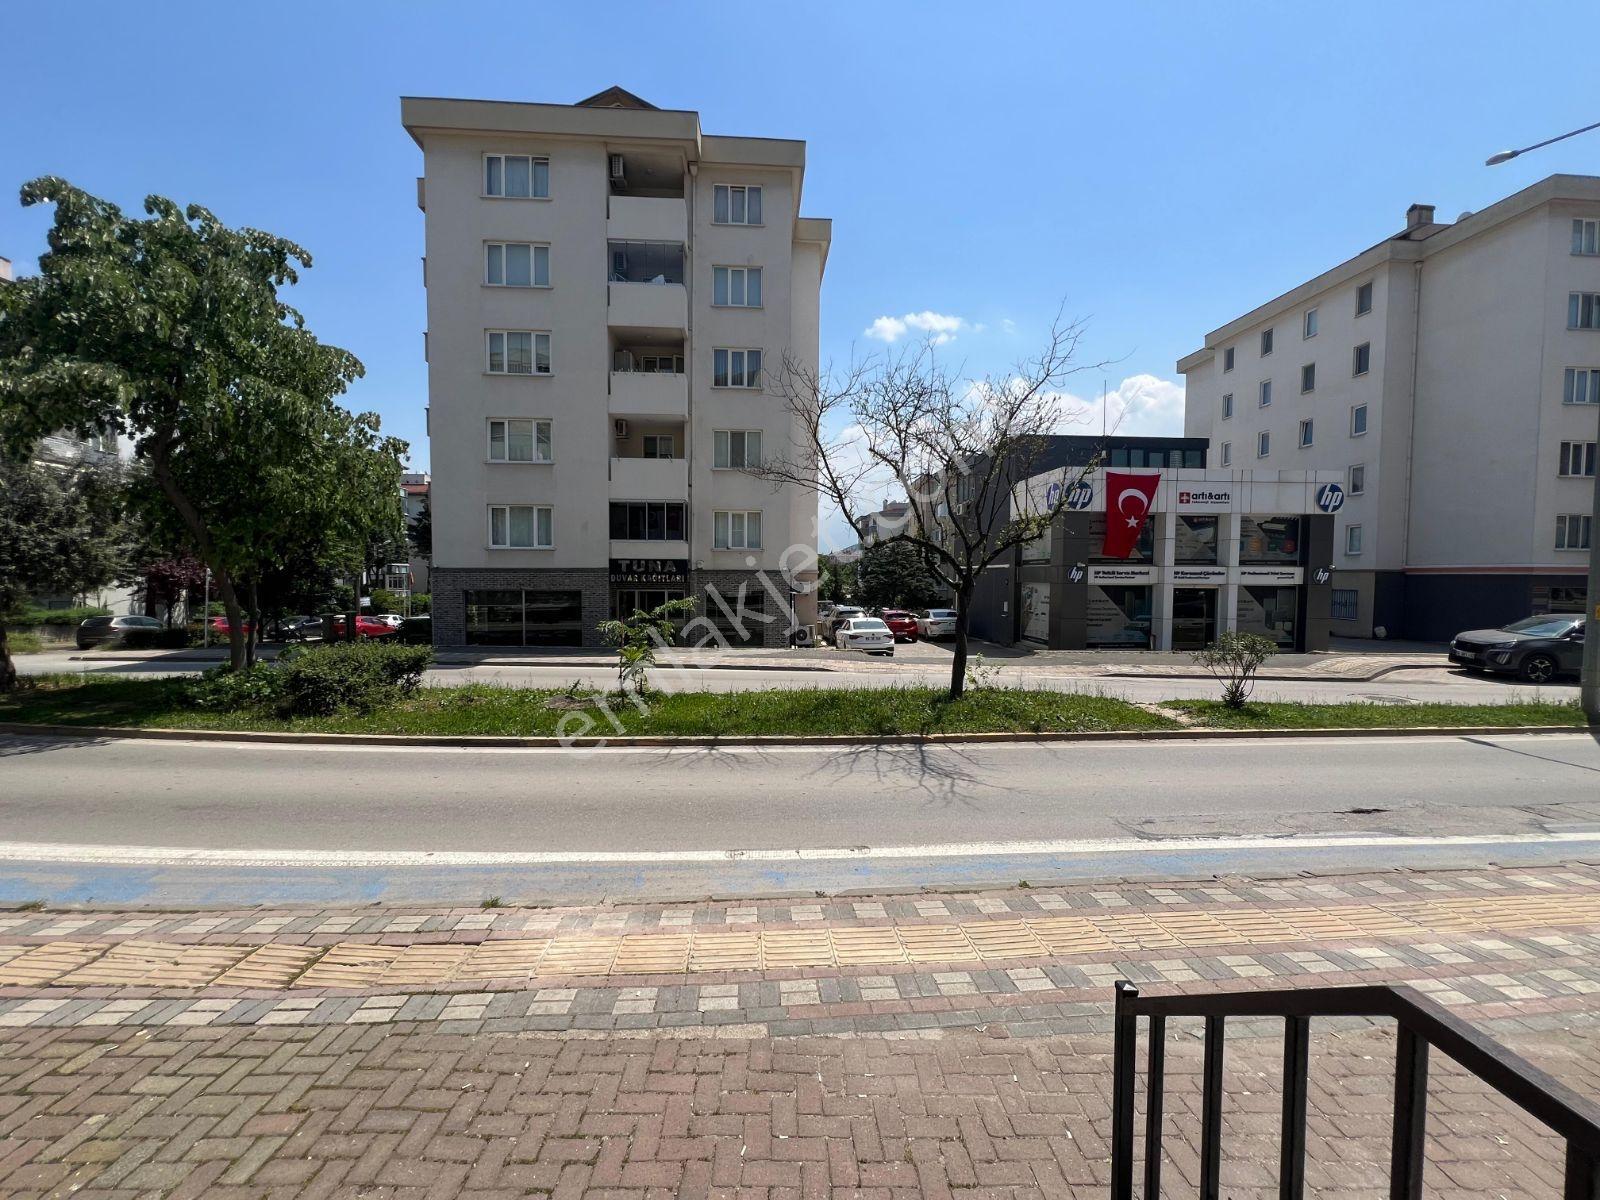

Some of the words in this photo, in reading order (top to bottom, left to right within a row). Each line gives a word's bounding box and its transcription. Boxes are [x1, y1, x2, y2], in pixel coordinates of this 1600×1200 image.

[1320, 483, 1343, 513] hp
[617, 560, 677, 572] TUNA
[610, 574, 638, 582] DUVAR
[1070, 566, 1083, 583] hp
[1316, 568, 1329, 584] hp
